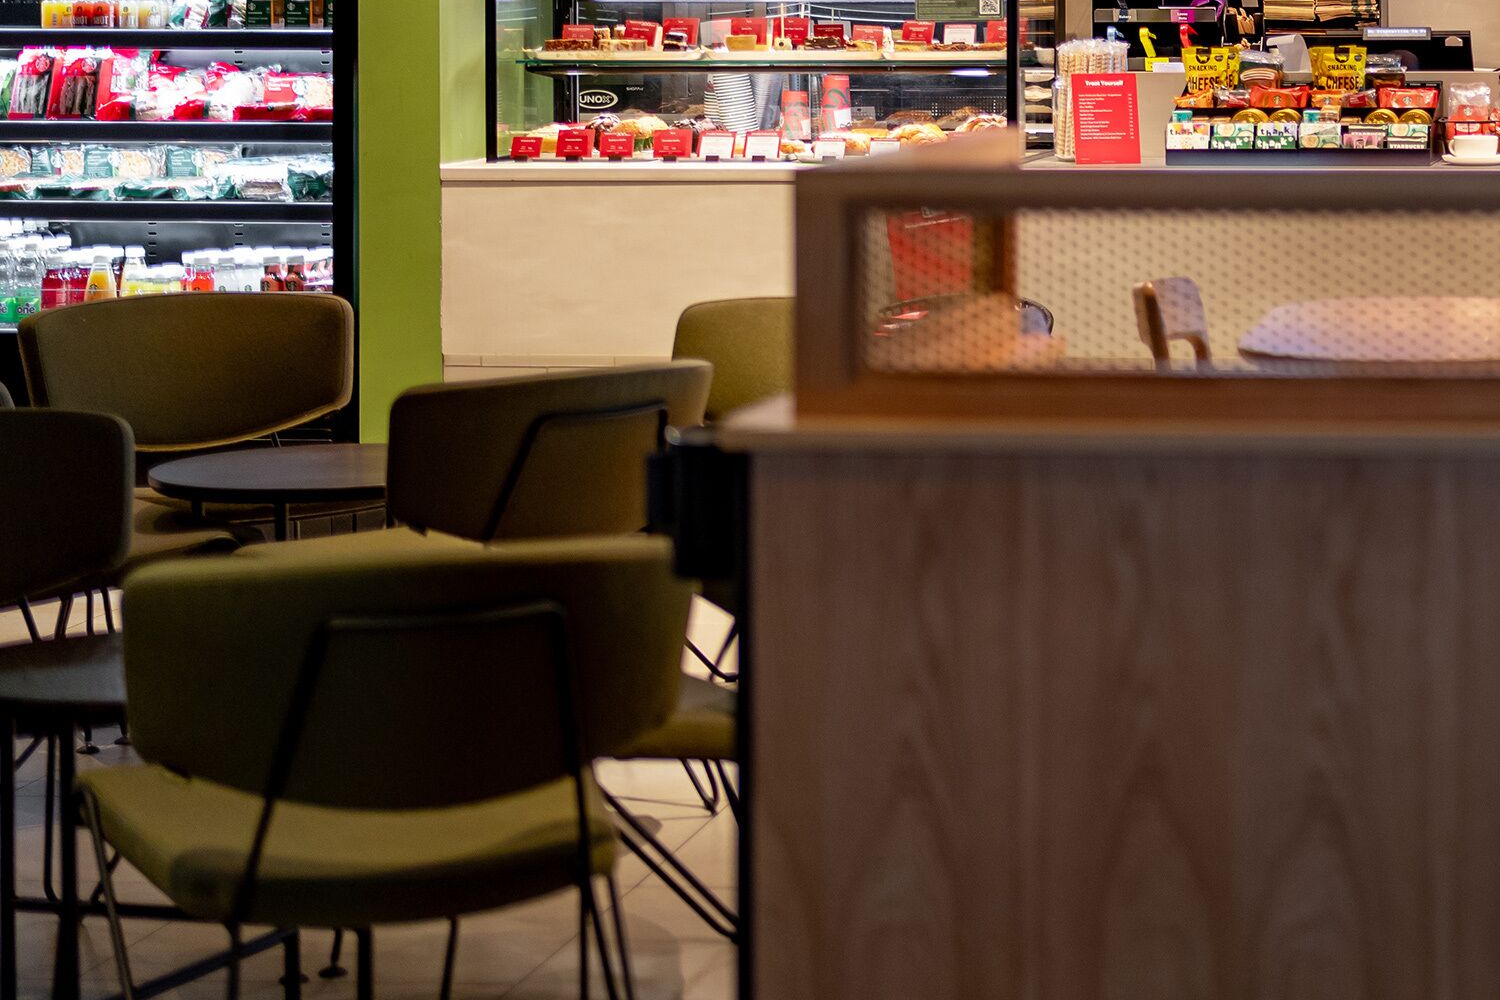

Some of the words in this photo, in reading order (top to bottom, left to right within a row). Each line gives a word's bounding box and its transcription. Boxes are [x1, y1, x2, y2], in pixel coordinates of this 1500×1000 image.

[1188, 64, 1218, 72] SNACKING
[1327, 64, 1358, 72] SNACKING
[1326, 75, 1360, 90] CHEESE
[1212, 137, 1245, 150] thank
[1256, 137, 1288, 150] thank
